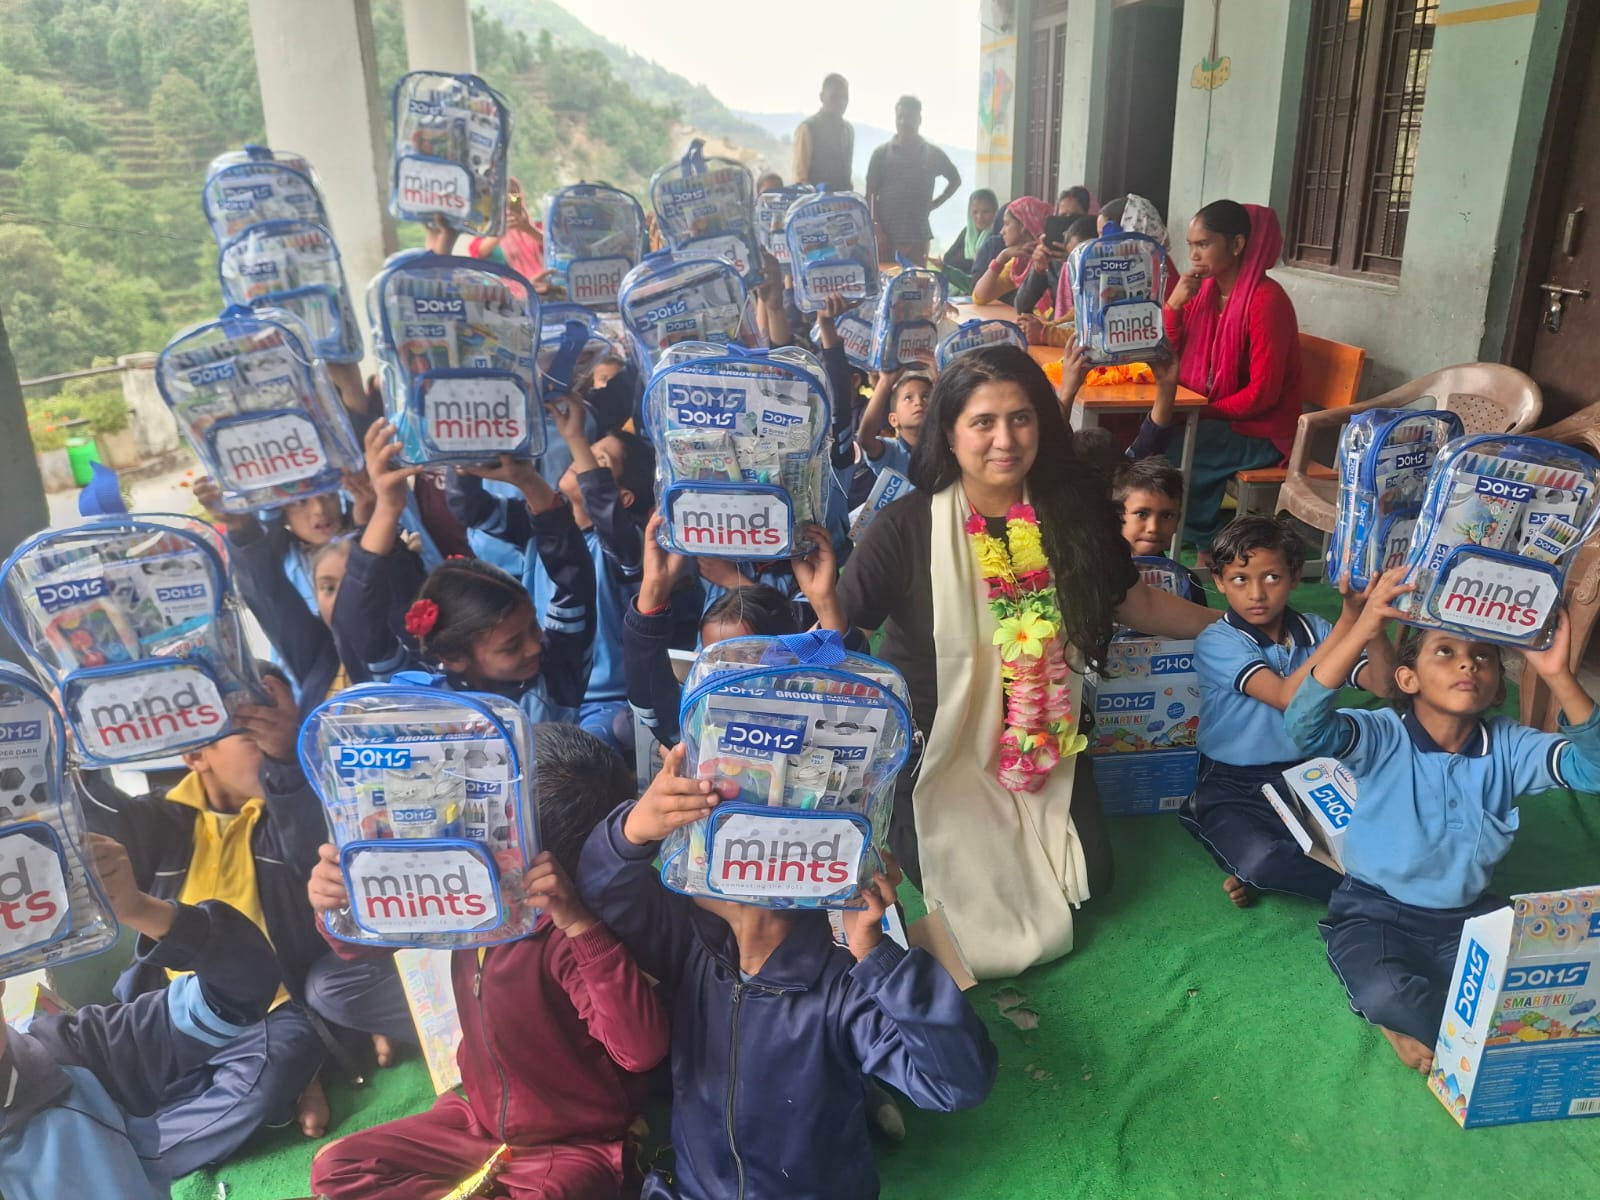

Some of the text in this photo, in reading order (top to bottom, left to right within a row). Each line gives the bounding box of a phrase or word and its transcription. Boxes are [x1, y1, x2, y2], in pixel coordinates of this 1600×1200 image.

[404, 175, 458, 195] mind
[404, 189, 465, 209] mints
[673, 190, 703, 202] DOMS
[1103, 261, 1129, 270] DOMS
[575, 267, 621, 286] mind
[812, 272, 857, 286] mind
[576, 283, 619, 297] mint
[416, 300, 462, 312] DOMS
[648, 301, 686, 321] DOMS
[1109, 311, 1153, 331] mind
[1109, 326, 1158, 344] mints
[190, 365, 234, 383] DOMS
[433, 394, 510, 419] mind
[671, 389, 744, 408] DOMS
[680, 410, 733, 426] DOMS
[434, 417, 520, 439] mints
[226, 427, 304, 464] mind
[233, 447, 319, 481] mints
[1397, 454, 1425, 467] DOMS
[1479, 480, 1530, 499] DOMS
[682, 506, 770, 529] mind
[683, 524, 781, 545] mints
[1535, 539, 1560, 553] DOMS
[1430, 545, 1446, 570] OMS
[40, 580, 102, 604] DOMS
[158, 585, 205, 600] DOMS
[1452, 576, 1541, 608] mind
[1444, 593, 1539, 627] mints
[1153, 657, 1192, 671] OMS
[91, 682, 201, 727] mind
[775, 690, 824, 701] GROOVE
[1100, 695, 1153, 709] DOMS
[98, 704, 220, 747] mints
[1100, 714, 1129, 726] SMART
[0, 724, 39, 740] OMS
[396, 735, 443, 743] GROOVE
[731, 727, 799, 749] DOMS
[342, 748, 409, 767] DOMS
[833, 748, 865, 758] OMS
[466, 782, 498, 793] OMS
[394, 809, 435, 822] DOMS
[1314, 789, 1351, 825] DOMS
[724, 833, 841, 861] mind
[722, 858, 849, 883] mints
[361, 865, 470, 896] mind
[366, 892, 487, 918] mints
[1458, 942, 1484, 1021] DOMS
[1507, 966, 1585, 988] DOMS
[1503, 991, 1578, 1009] SMART KIT
